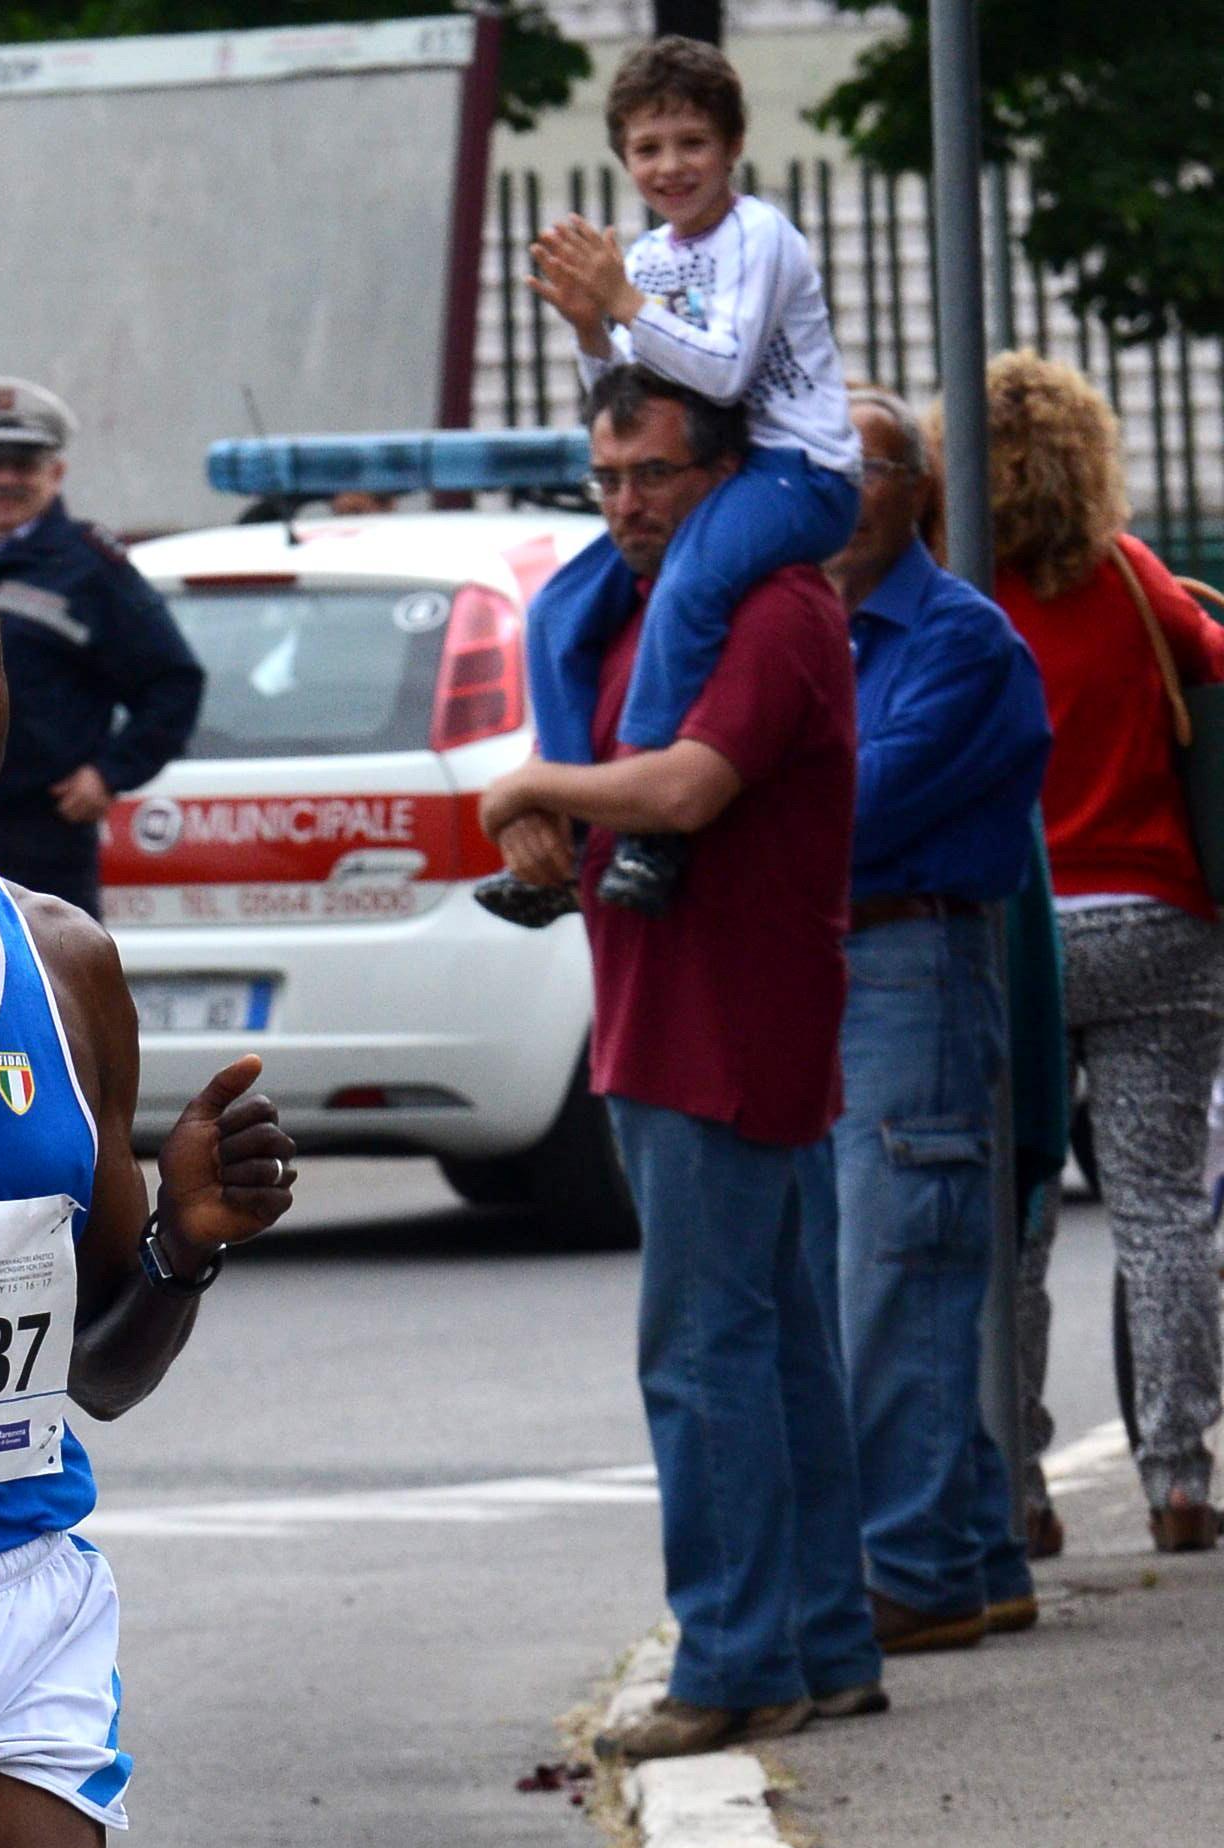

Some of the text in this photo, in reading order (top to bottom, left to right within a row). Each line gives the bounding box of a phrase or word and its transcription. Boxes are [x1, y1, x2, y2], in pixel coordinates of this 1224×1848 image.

[185, 799, 414, 843] MUNICIPALE
[8, 1283, 18, 1293] 15
[26, 1281, 35, 1290] 16
[43, 1278, 52, 1287] 17
